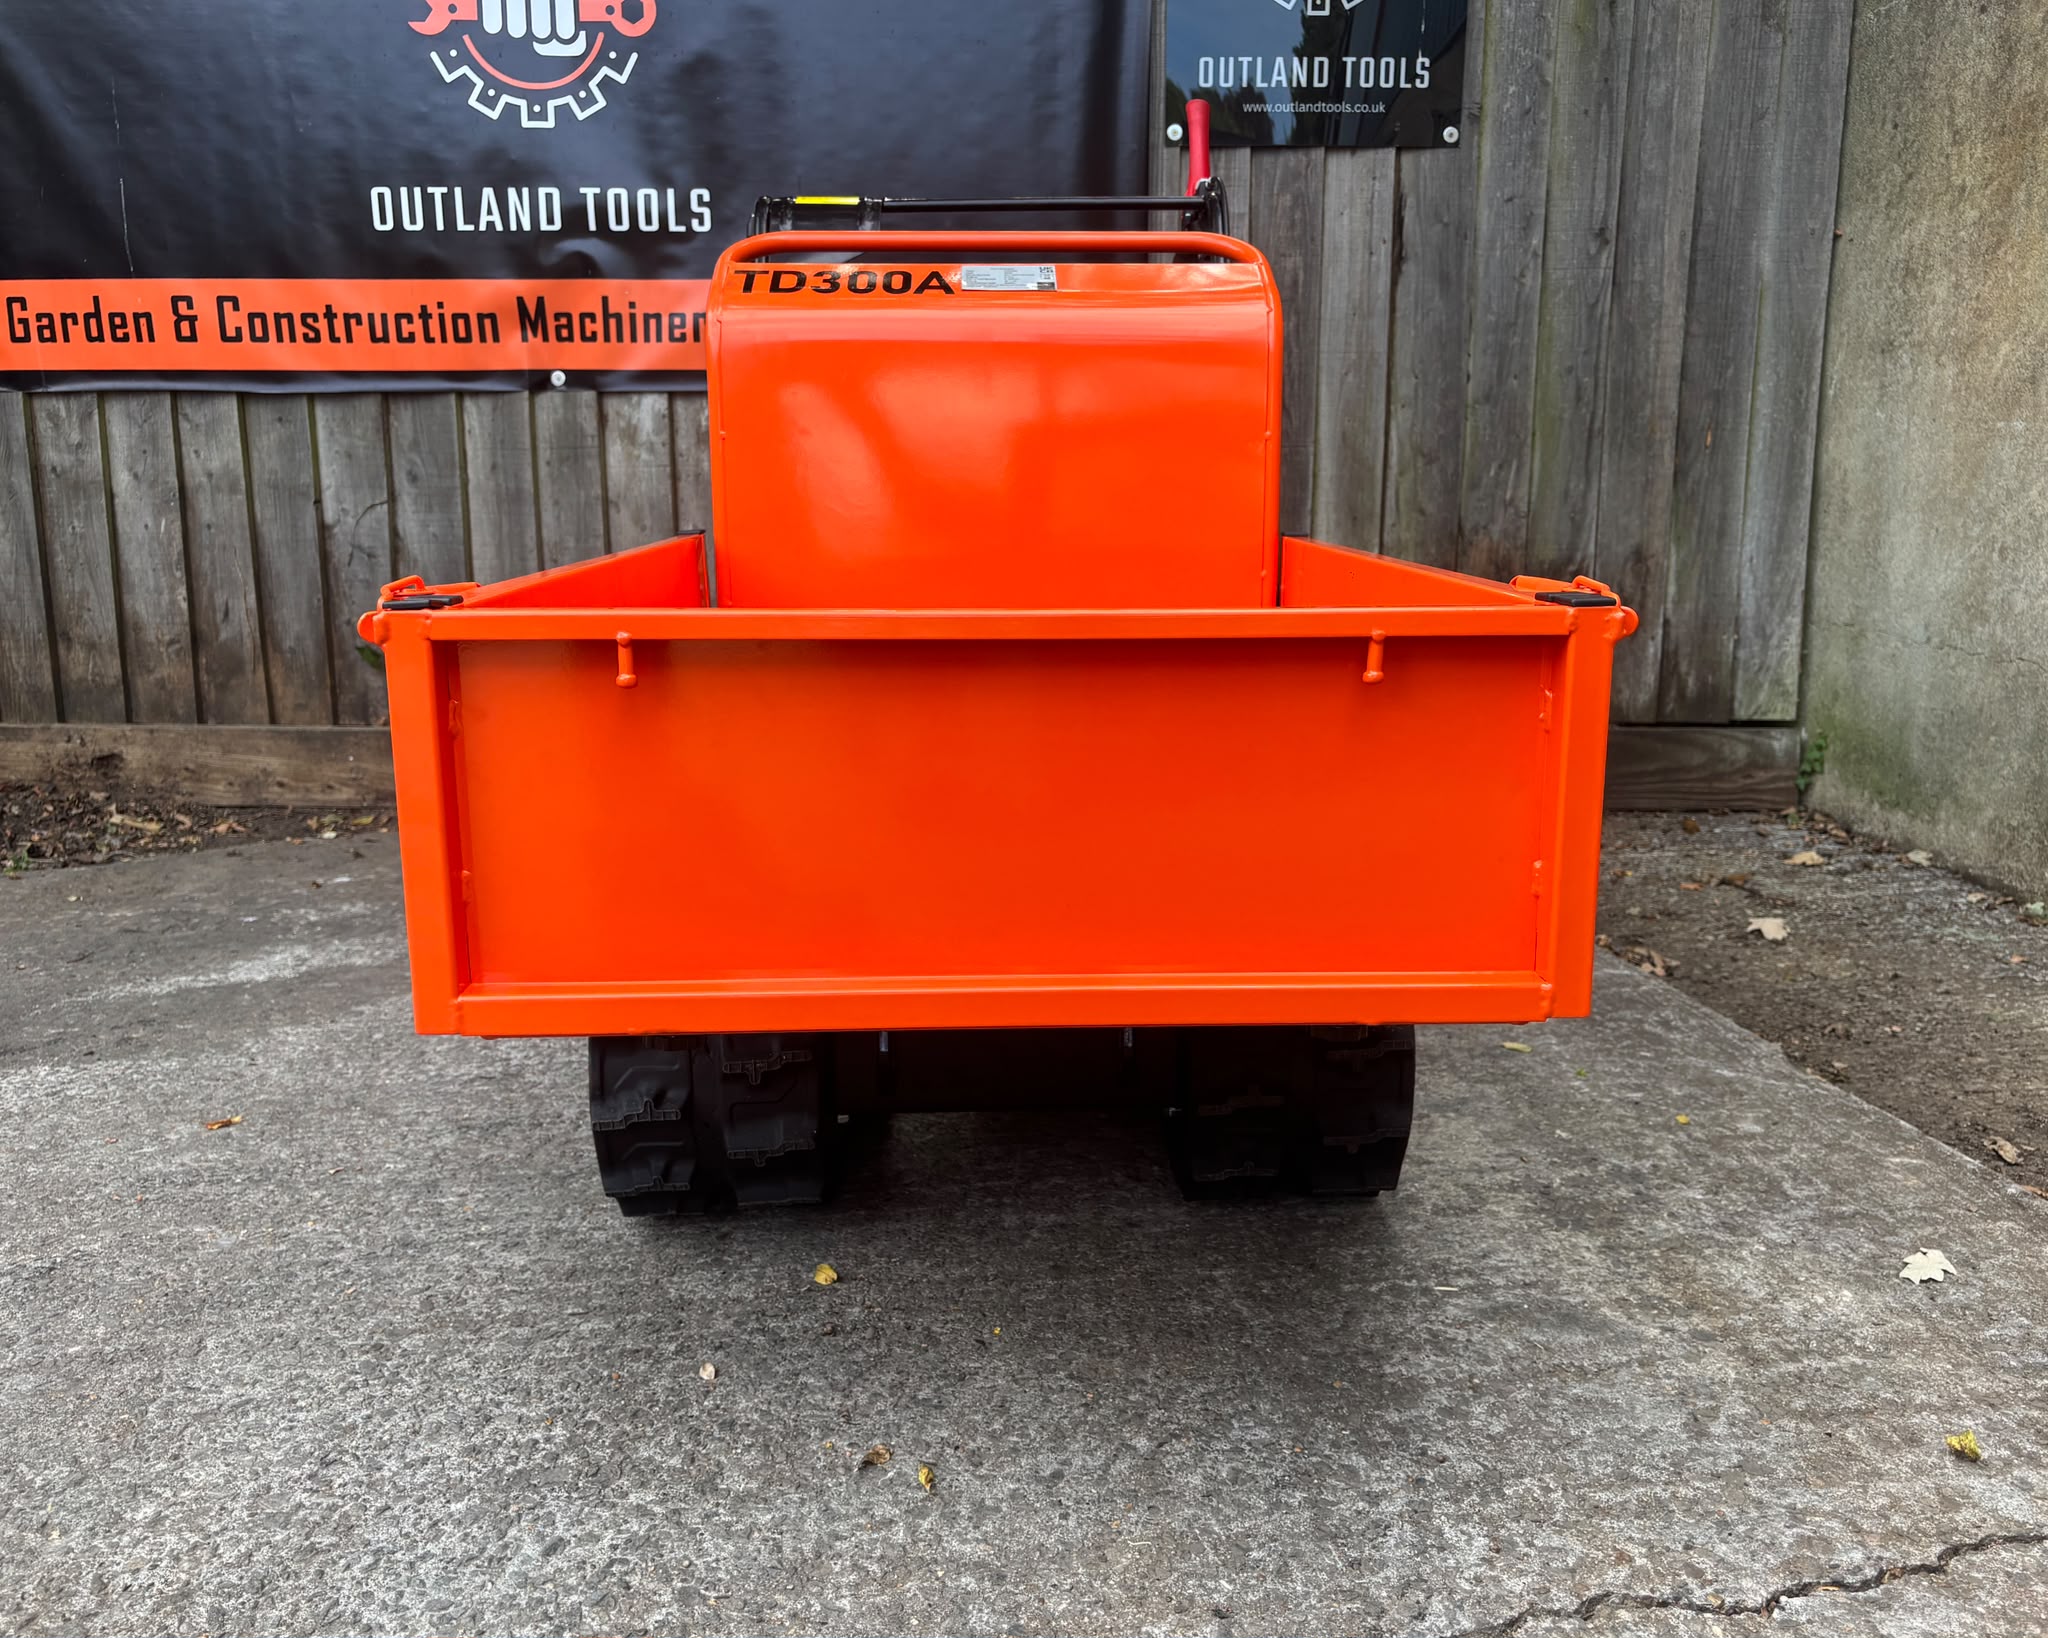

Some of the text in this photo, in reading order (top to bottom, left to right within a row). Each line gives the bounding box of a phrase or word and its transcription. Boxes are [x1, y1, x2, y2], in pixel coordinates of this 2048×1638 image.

[1198, 56, 1431, 89] OUTLAND TOOLS
[1243, 101, 1386, 113] www.outlandtools.co.uk
[370, 186, 712, 233] OUTLAND TOOLS
[733, 269, 956, 295] TD300A
[5, 295, 156, 344] Garden
[170, 295, 199, 343] &
[215, 295, 501, 344] Construction
